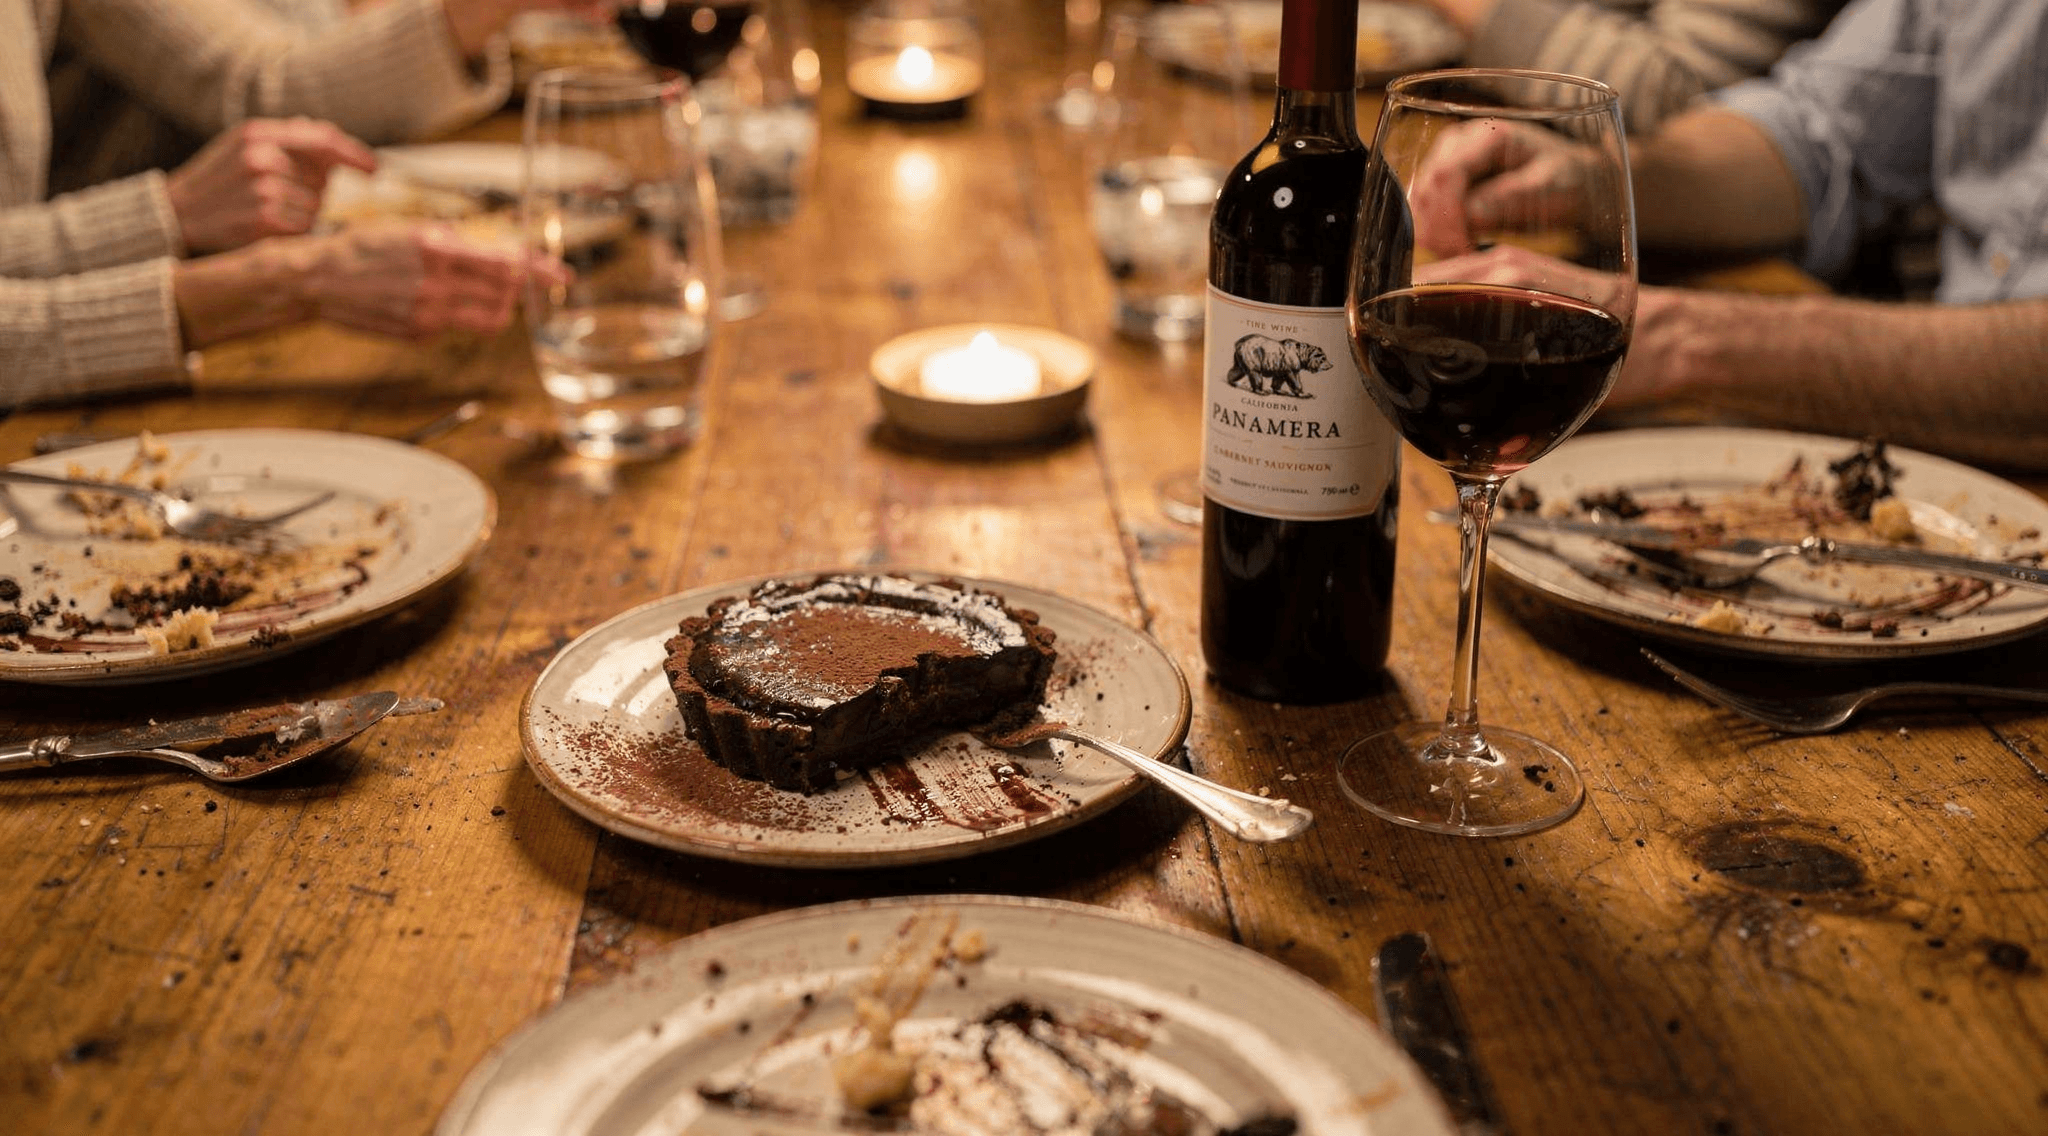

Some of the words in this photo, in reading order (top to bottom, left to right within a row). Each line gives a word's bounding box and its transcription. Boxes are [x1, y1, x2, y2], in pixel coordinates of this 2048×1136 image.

[1271, 323, 1299, 334] WINE
[1212, 402, 1341, 439] PANAMERA
[1263, 459, 1332, 472] SAUVIGNON
